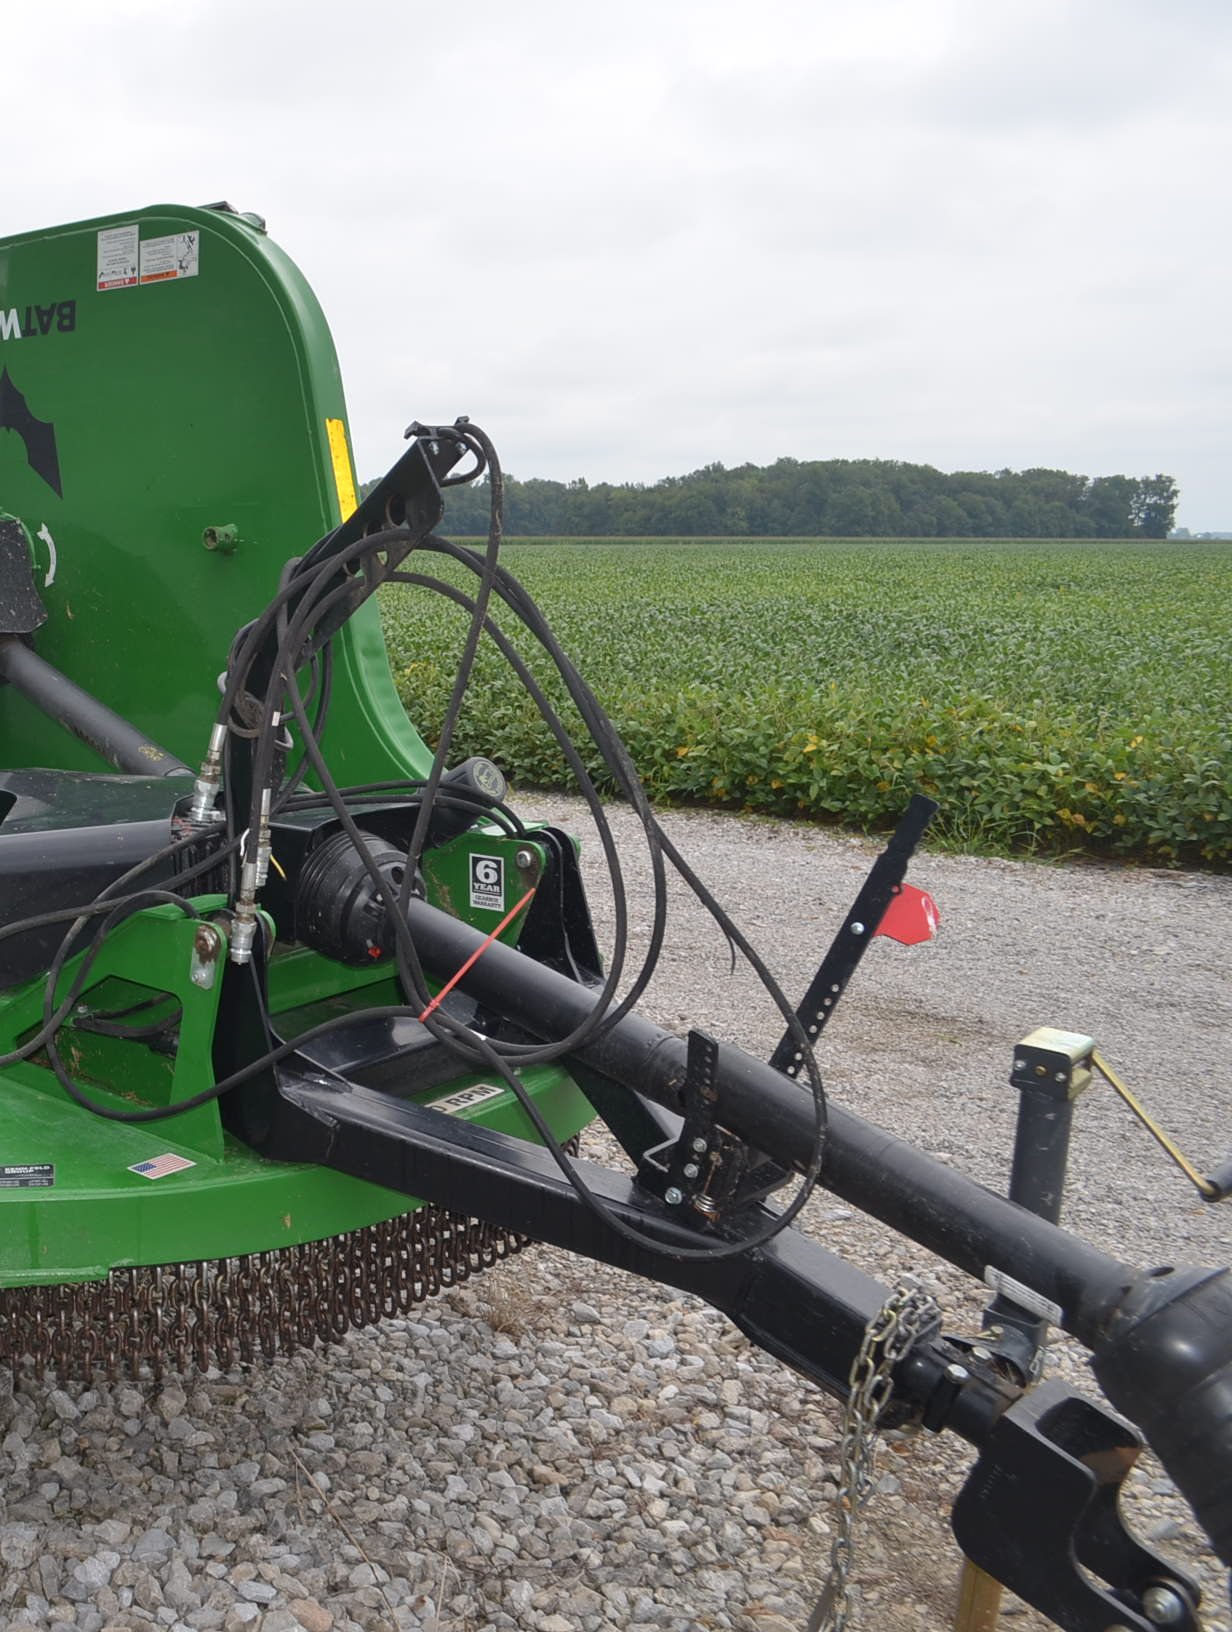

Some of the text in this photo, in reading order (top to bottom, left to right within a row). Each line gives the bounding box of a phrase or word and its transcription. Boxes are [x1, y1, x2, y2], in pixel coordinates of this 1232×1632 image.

[476, 860, 498, 884] 6
[473, 882, 501, 893] YEAR
[445, 1086, 497, 1106] RPM
